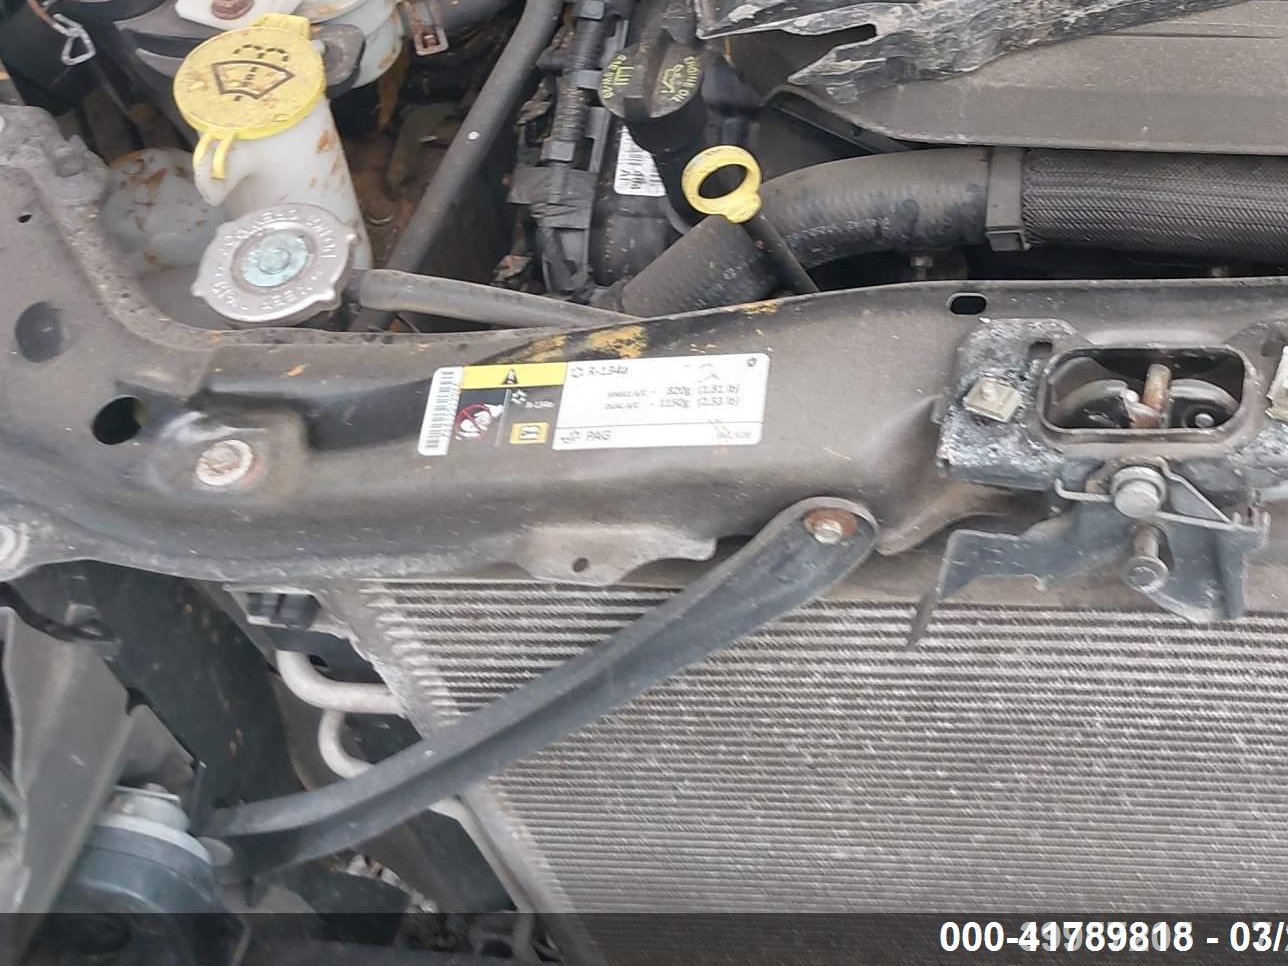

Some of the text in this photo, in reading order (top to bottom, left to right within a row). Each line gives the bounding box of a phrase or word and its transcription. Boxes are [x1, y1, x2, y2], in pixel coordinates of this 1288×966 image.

[683, 56, 699, 88] ENGINE
[587, 364, 628, 376] R-134a
[585, 429, 612, 442] PAG
